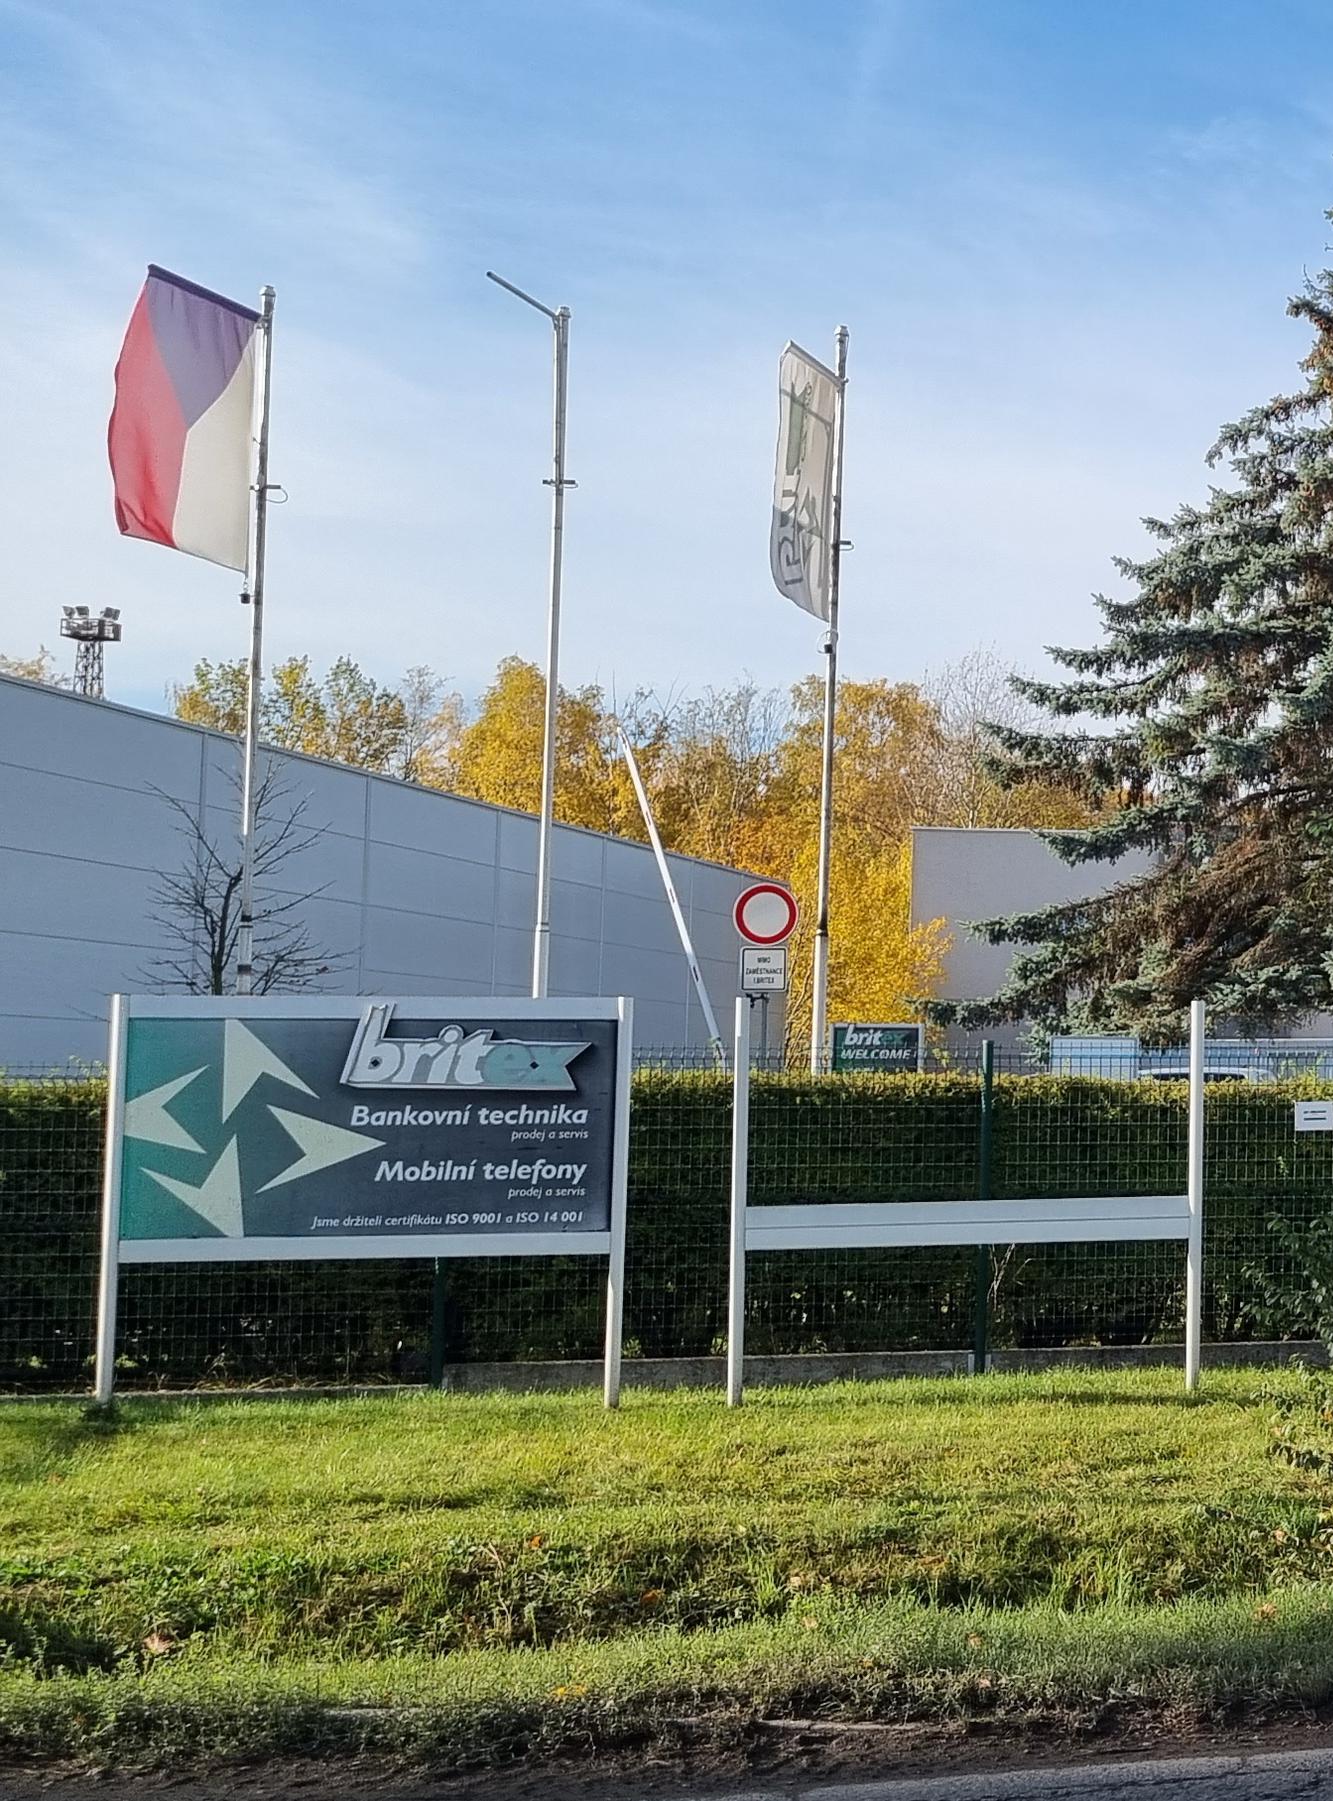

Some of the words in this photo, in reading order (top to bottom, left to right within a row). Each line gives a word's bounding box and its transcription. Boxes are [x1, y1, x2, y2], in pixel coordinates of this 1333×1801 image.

[343, 1004, 586, 1087] britex
[840, 1048, 911, 1060] WELCOME
[351, 1104, 472, 1126] Bankovní
[478, 1104, 588, 1125] technika
[511, 1130, 546, 1142] prodej
[549, 1131, 556, 1139] a
[559, 1130, 588, 1139] servis
[374, 1160, 476, 1182] Mobilní
[483, 1159, 588, 1185] telefony
[508, 1187, 542, 1200] prodej
[545, 1189, 552, 1197] a
[556, 1187, 585, 1197] servis
[310, 1216, 340, 1230] Jsme
[342, 1214, 382, 1227] držiteli
[385, 1213, 442, 1228] certifikátu
[445, 1213, 469, 1225] ISO
[472, 1212, 502, 1224] 9001
[506, 1215, 513, 1223] a
[516, 1211, 539, 1223] ISO
[544, 1211, 558, 1222] 14
[561, 1211, 583, 1222] 001
